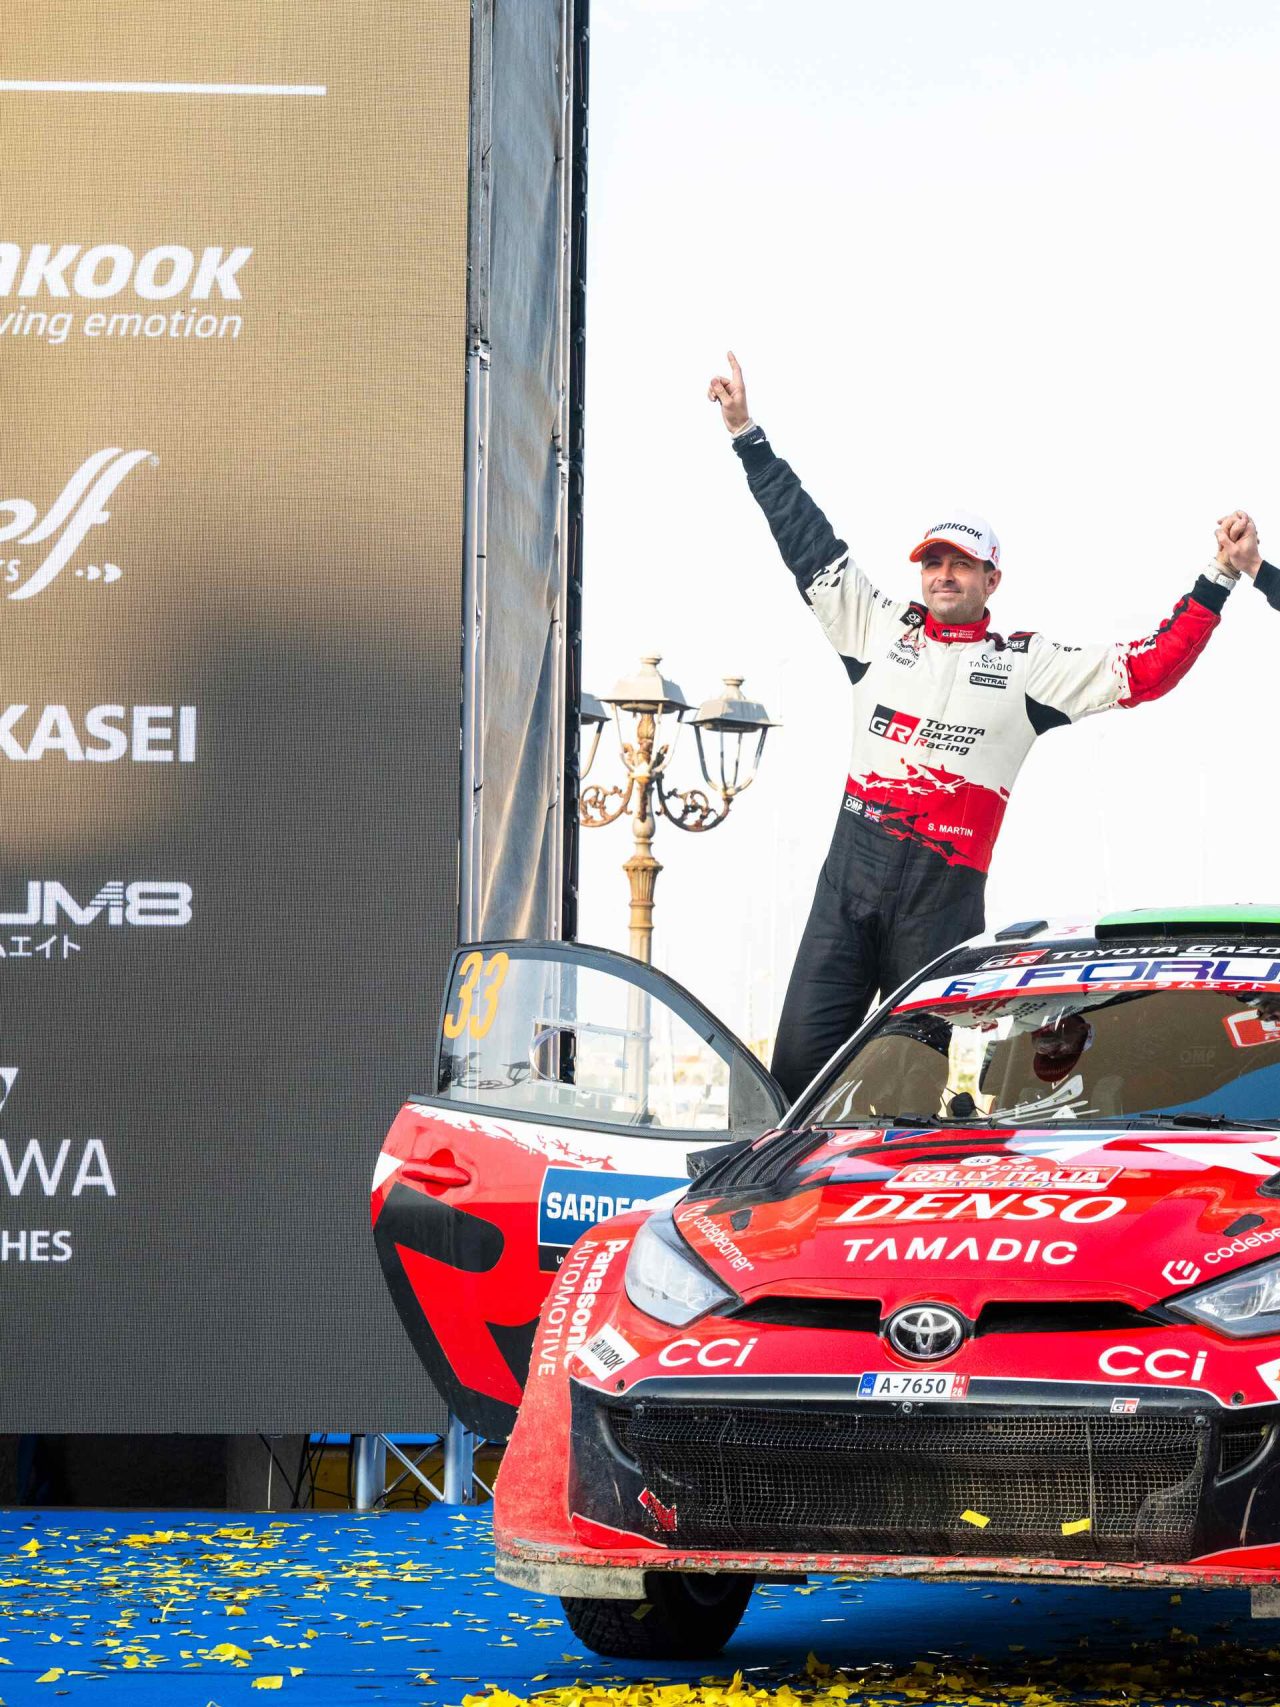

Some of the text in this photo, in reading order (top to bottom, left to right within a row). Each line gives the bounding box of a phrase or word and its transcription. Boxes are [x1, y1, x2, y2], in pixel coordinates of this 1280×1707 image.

[83, 306, 243, 339] emotion
[968, 661, 1012, 672] TAMADIC
[969, 675, 1008, 686] CENTRAL
[869, 715, 913, 744] GR
[920, 728, 976, 745] GAZOO
[926, 718, 986, 736] TOYOTA
[914, 738, 970, 756] Racing
[845, 799, 863, 811] OMP
[928, 823, 974, 837] S. MARTIN
[0, 934, 81, 960] エイト
[986, 954, 1041, 970] GR
[1052, 945, 1178, 960] TOYOTA
[443, 951, 510, 1040] 33
[905, 1171, 1101, 1183] RALLY ITALIA
[988, 1164, 1038, 1172] 2026
[834, 1194, 1128, 1225] DENSO
[693, 1215, 755, 1273] codebeamer
[841, 1237, 1078, 1266] TAMADIC
[538, 1240, 599, 1377] AUTOMOTIVE
[563, 1239, 630, 1370] Panasonic
[658, 1337, 759, 1368] CCi
[1098, 1346, 1208, 1381] CCi
[879, 1377, 947, 1394] A-7650
[955, 1376, 966, 1384] 11
[1112, 1402, 1138, 1413] GR
